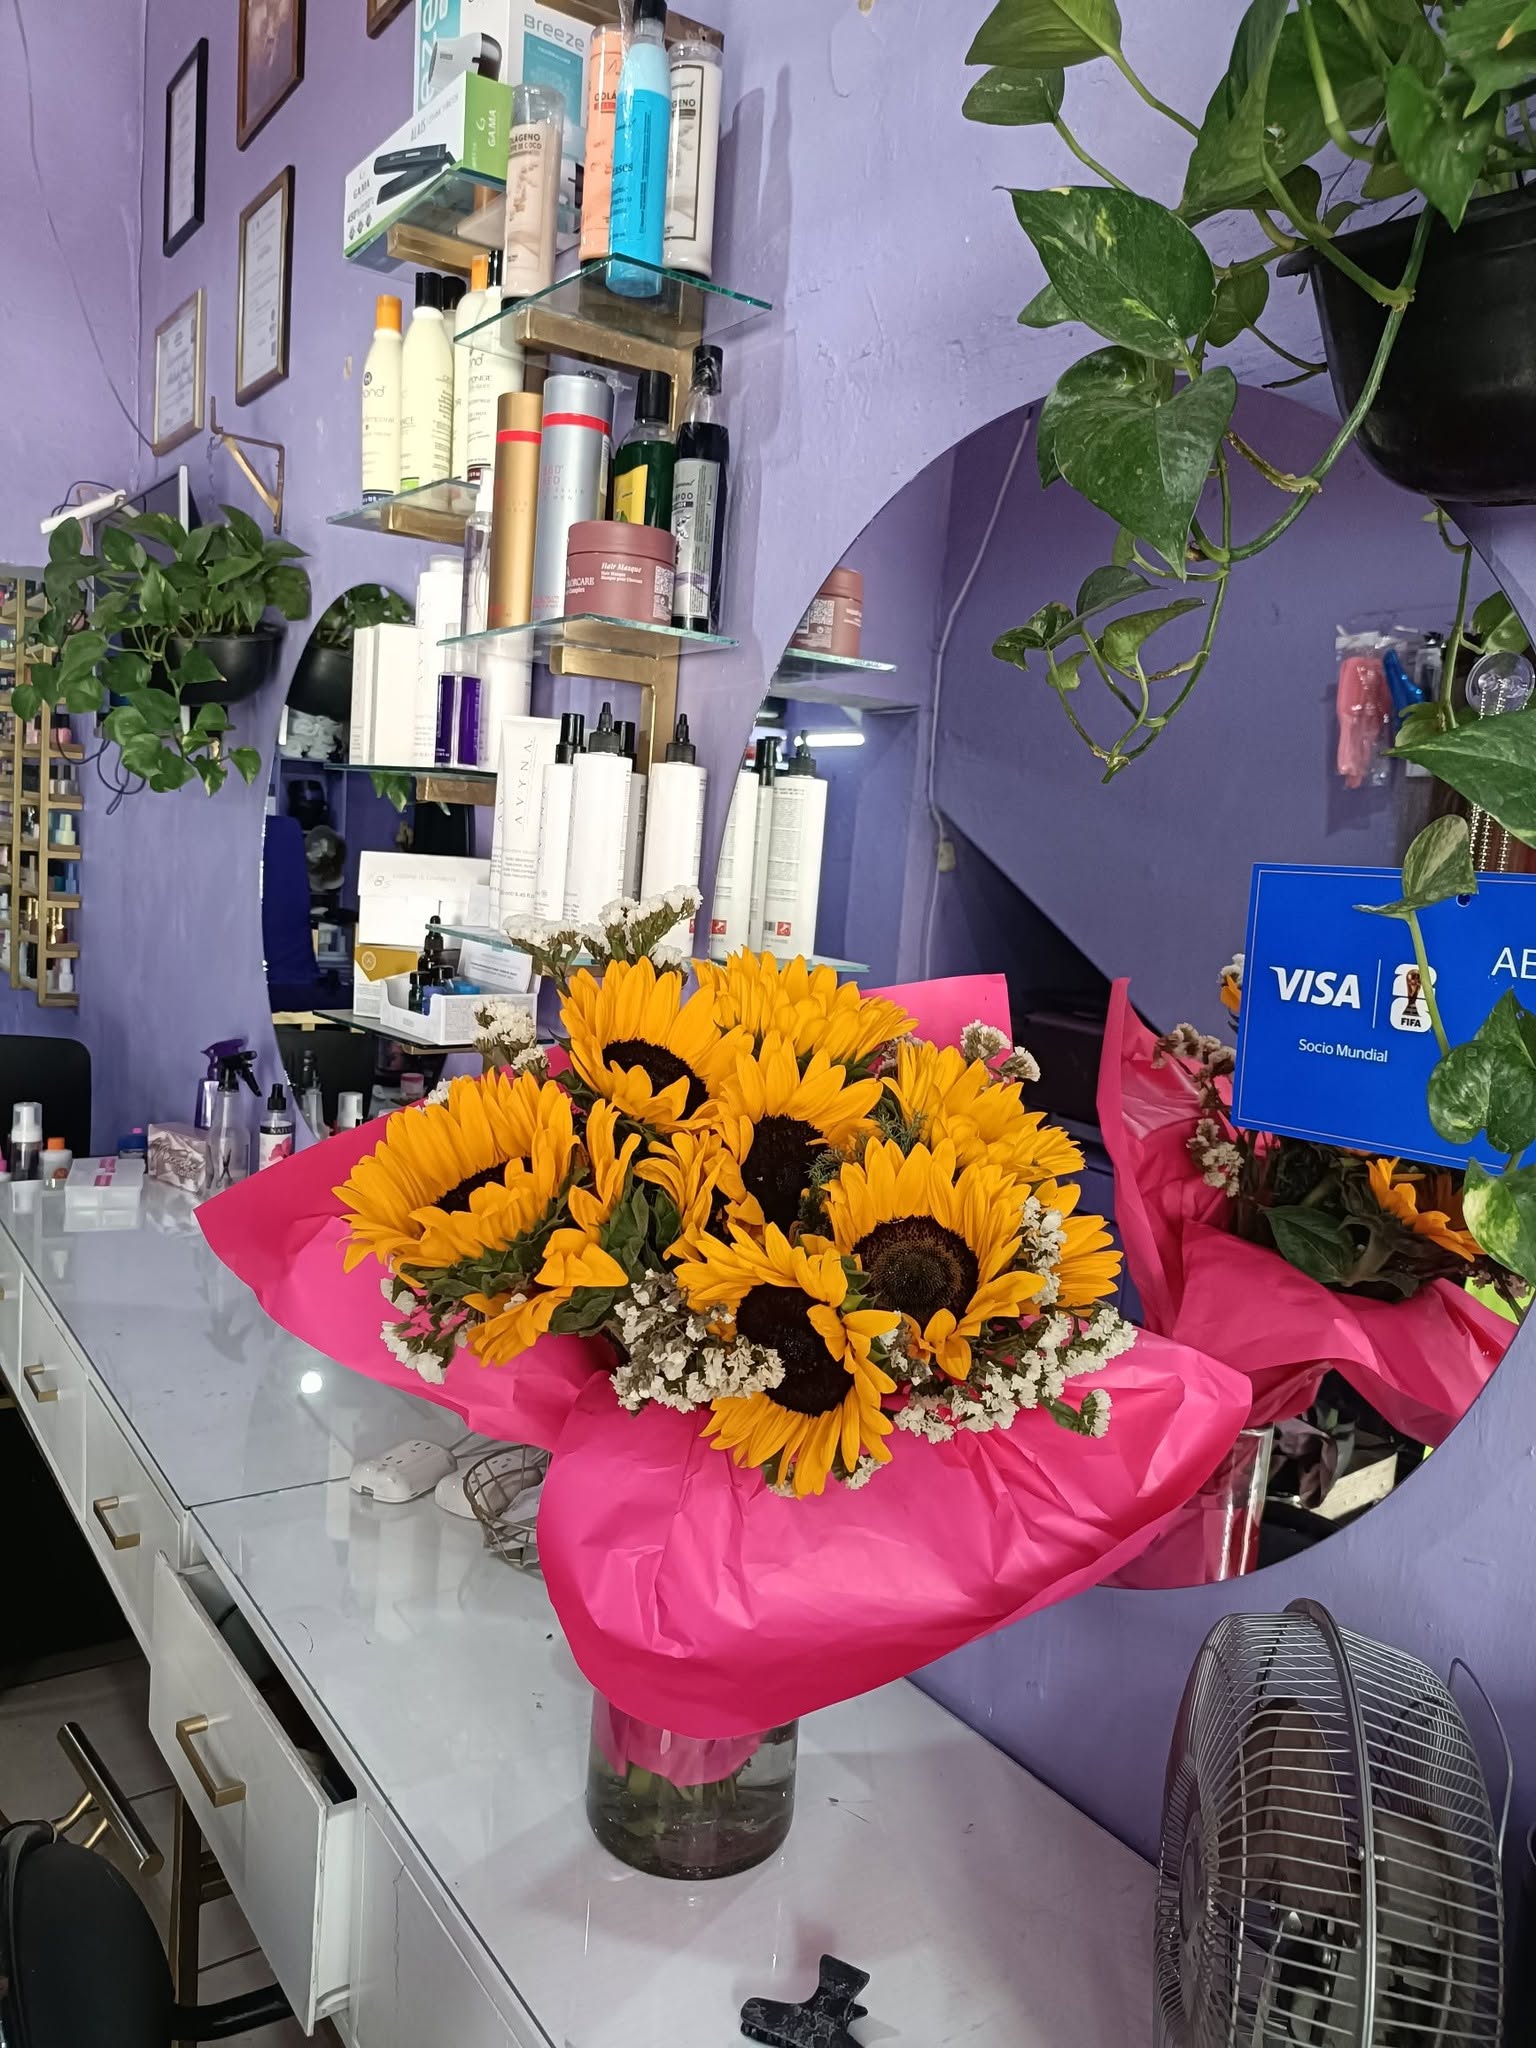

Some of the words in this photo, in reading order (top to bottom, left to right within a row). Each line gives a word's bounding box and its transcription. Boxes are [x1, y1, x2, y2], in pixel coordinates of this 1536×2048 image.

[523, 13, 586, 52] Breeze
[487, 109, 497, 147] GAMA
[353, 178, 370, 199] GAMA
[601, 562, 616, 570] Hair
[616, 563, 642, 574] Masque
[1269, 966, 1361, 1010] VISA
[1400, 1017, 1422, 1028] FIFA
[1298, 1038, 1334, 1055] Socio
[1336, 1044, 1388, 1063] Mundial
